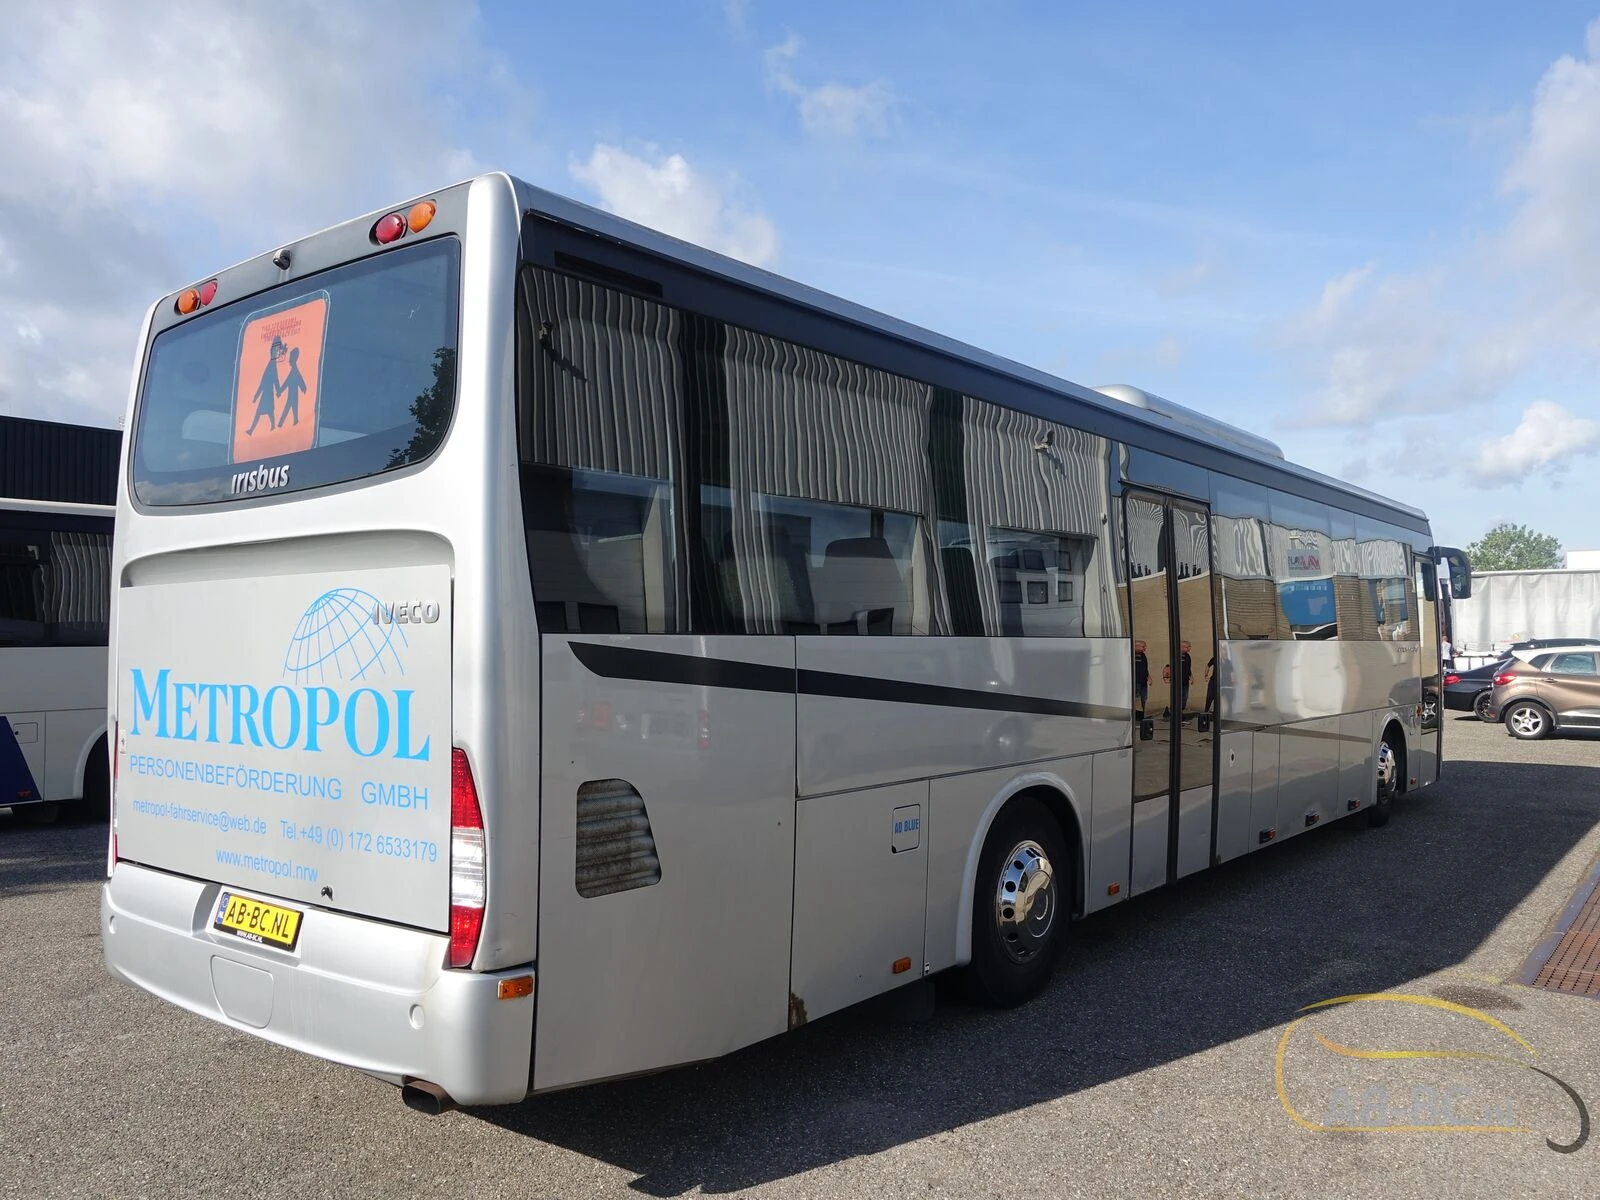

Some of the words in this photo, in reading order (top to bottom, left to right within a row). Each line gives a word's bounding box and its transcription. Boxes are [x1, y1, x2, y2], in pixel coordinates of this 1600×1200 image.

[231, 464, 290, 495] irisbus
[372, 600, 440, 625] IVECO
[130, 756, 342, 800] PERSONENBEFÖRDERUNG
[361, 781, 429, 810] GMBH
[132, 799, 267, 835] metropol-fahrservice@web.de
[326, 827, 344, 852] (0)
[349, 832, 372, 852] 172
[376, 835, 438, 863] 6533179
[894, 822, 903, 834] AD
[904, 818, 920, 832] BLUE
[216, 849, 318, 882] www.metropol.nrw
